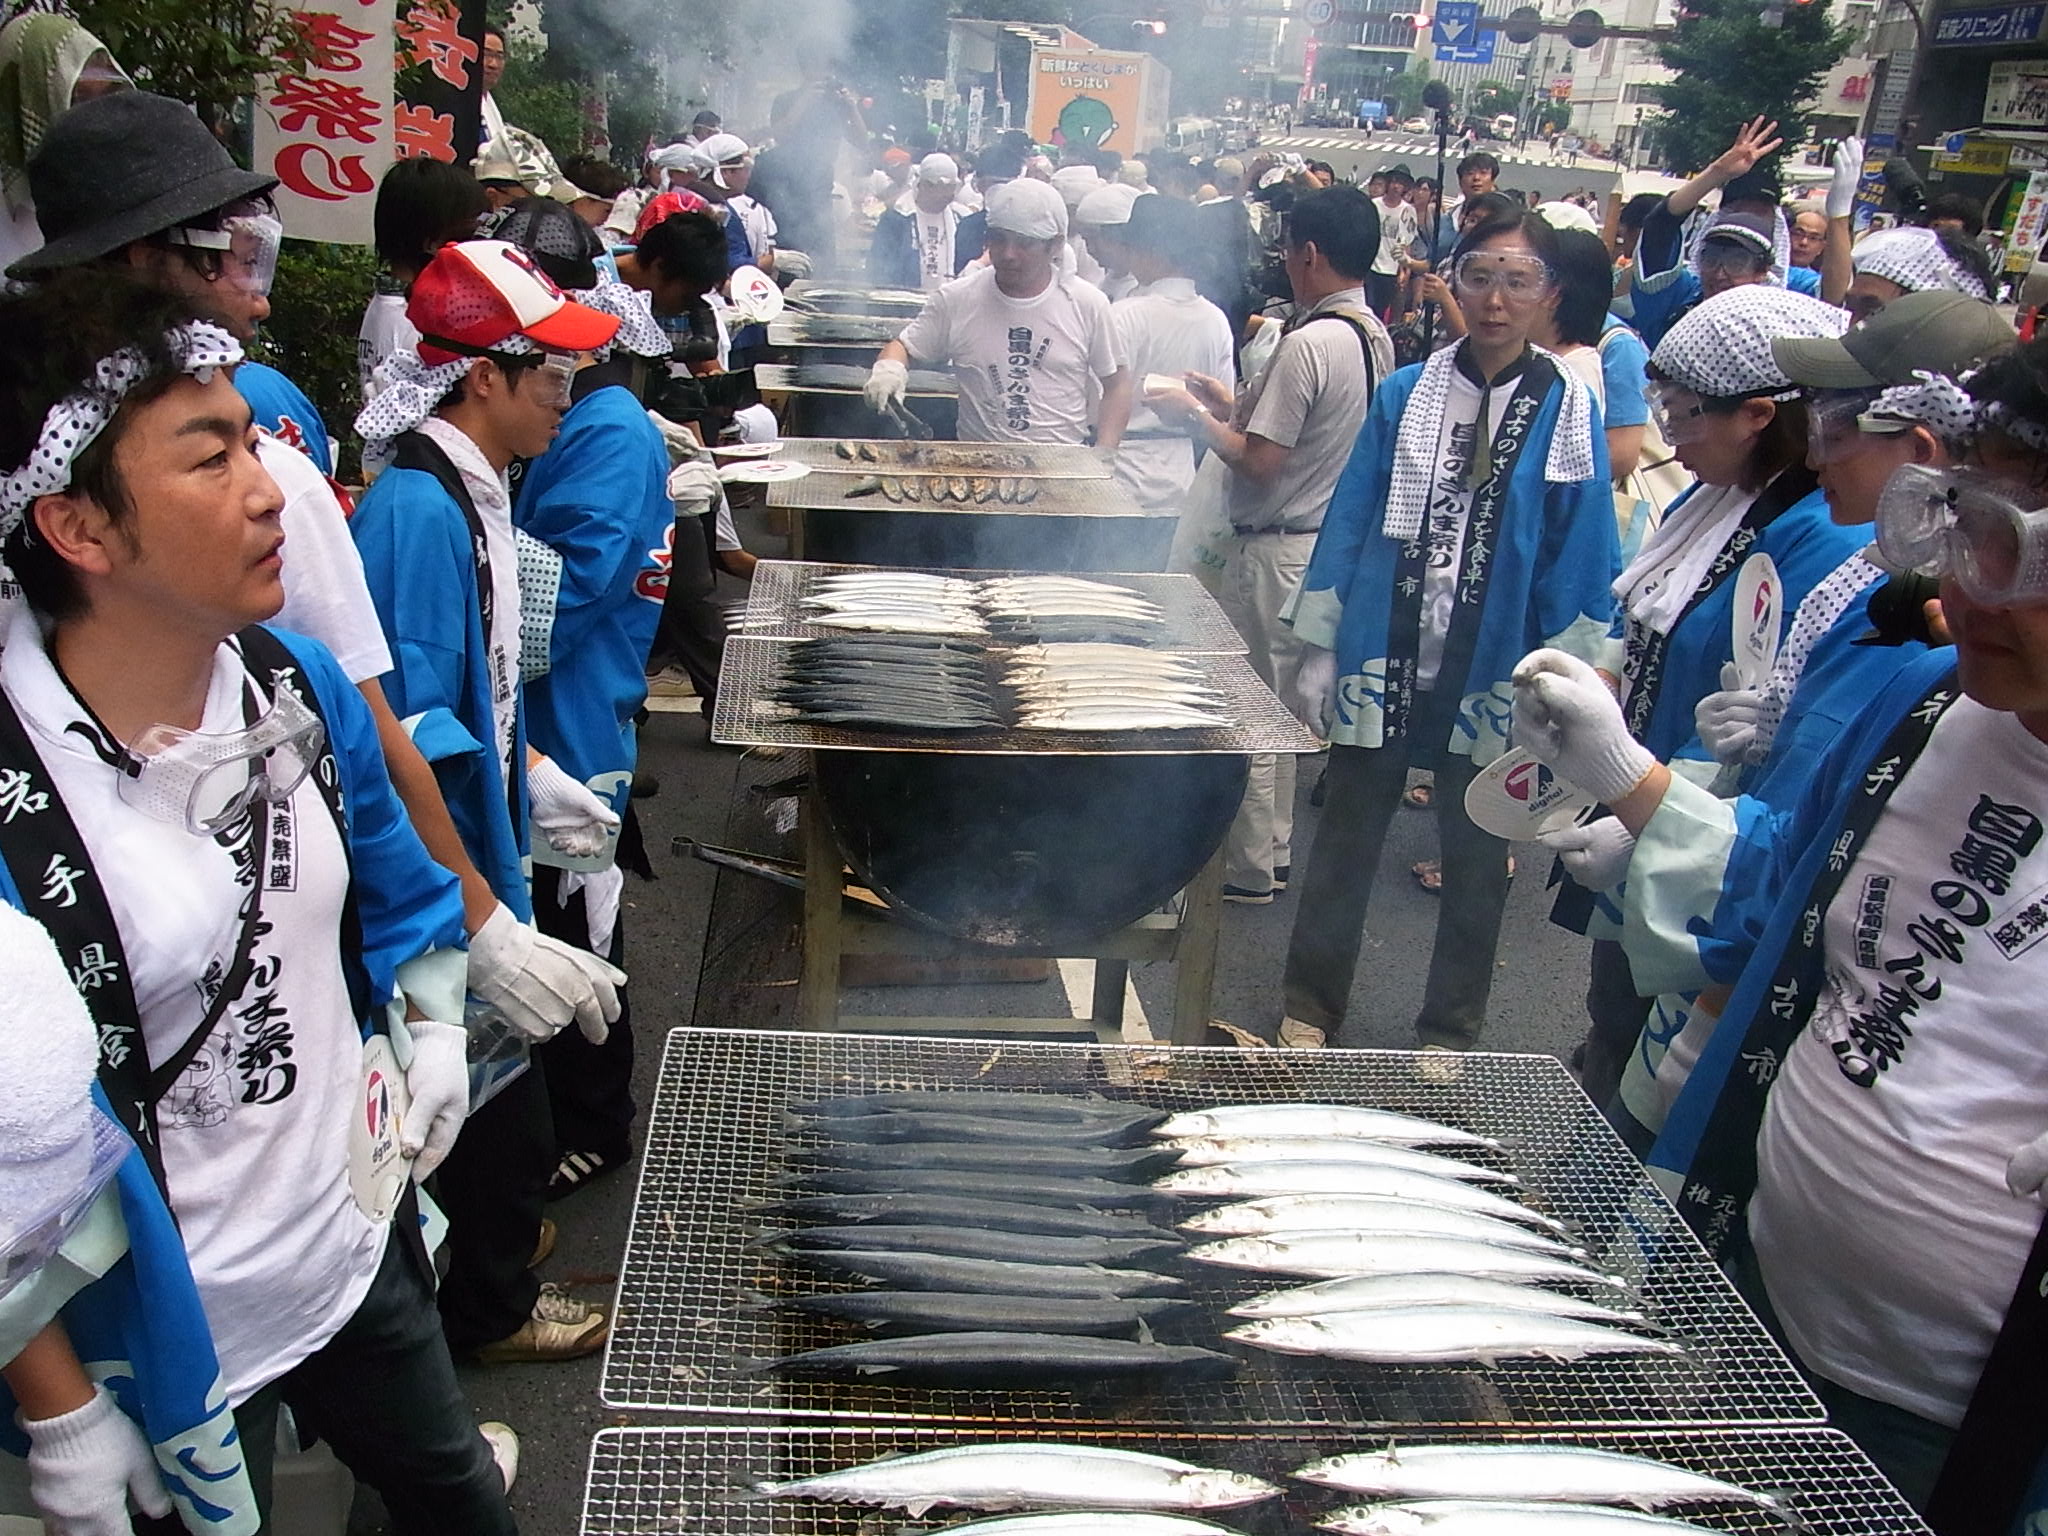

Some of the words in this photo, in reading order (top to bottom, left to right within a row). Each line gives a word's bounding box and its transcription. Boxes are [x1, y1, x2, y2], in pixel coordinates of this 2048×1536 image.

[1060, 77, 1108, 89] いっぱい
[1007, 326, 1032, 431] 目黒のさんま祭り
[1462, 394, 1539, 606] 宮古のさんまを食卓に
[1528, 786, 1565, 813] digital
[1830, 793, 2044, 1088] 目黒のさんま祭り
